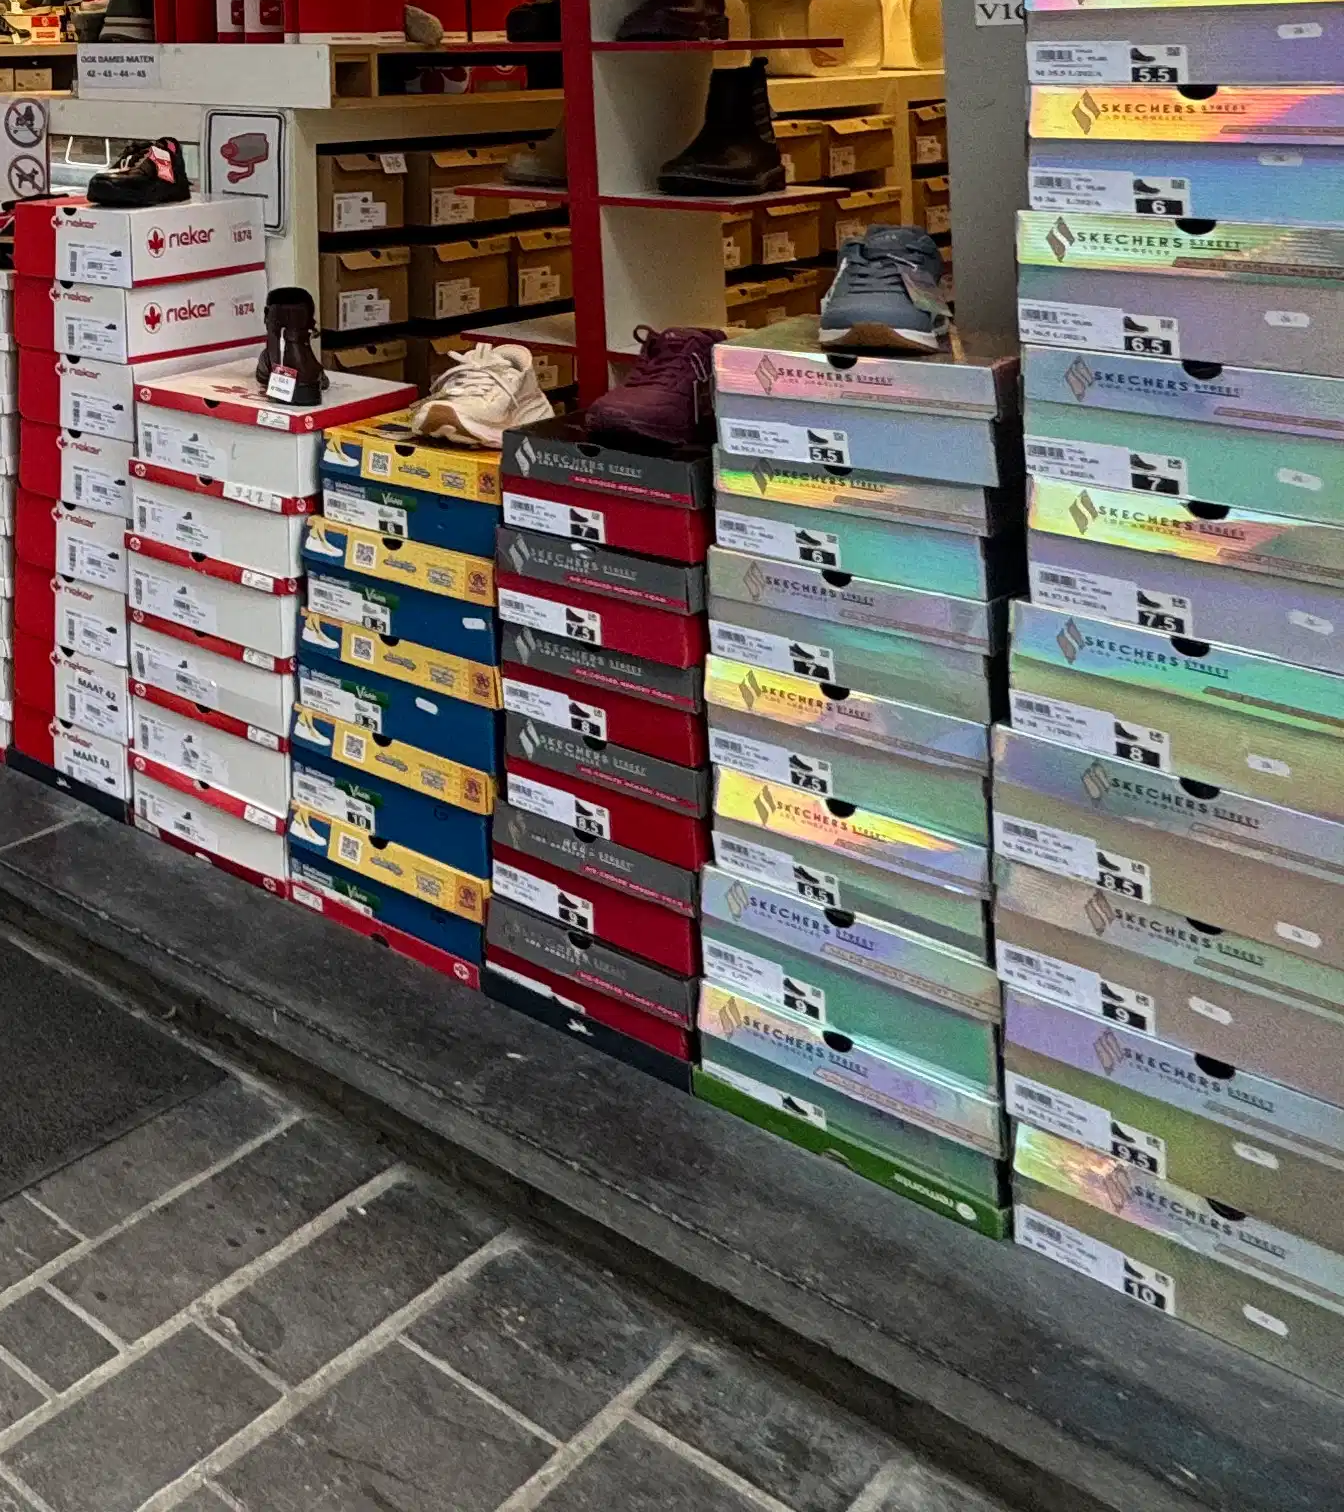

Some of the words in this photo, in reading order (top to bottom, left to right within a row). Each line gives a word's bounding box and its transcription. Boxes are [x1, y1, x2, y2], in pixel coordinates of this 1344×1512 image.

[1138, 67, 1171, 83] 5.5
[1100, 103, 1195, 115] SKECHERS
[1151, 200, 1166, 215] 6
[169, 225, 214, 248] rieker
[1077, 231, 1183, 248] SKECHERS
[1189, 238, 1241, 249] STREET
[166, 300, 215, 323] rieker
[1132, 338, 1163, 354] 6.5
[777, 366, 853, 383] SKECHERS
[1094, 370, 1189, 392] SKECHERS
[536, 449, 605, 471] SKECHERS
[811, 448, 839, 462] 5.5
[773, 467, 846, 487] SKECHERS
[1149, 476, 1162, 490] 7
[1098, 505, 1194, 531] SKECHERS
[811, 549, 823, 563] 6
[766, 574, 837, 599] SKECHERS
[1143, 612, 1177, 631] 7.5
[1085, 635, 1178, 666] SKECHERS
[78, 677, 105, 697] MAAT
[105, 690, 116, 702] 42
[760, 683, 834, 713] SKECHERS
[72, 748, 98, 765] MAAT
[99, 756, 110, 770] 43
[1129, 746, 1144, 762] 8
[1112, 777, 1208, 814] SKECHERS
[776, 799, 849, 833] SKECHERS
[1101, 875, 1136, 896] 8.5
[750, 895, 832, 937] SKECHERS
[1115, 908, 1213, 950] SKECHERS
[795, 998, 807, 1014] 9
[1115, 1007, 1130, 1023] 9
[743, 1014, 825, 1059] SKECHERS
[1123, 1046, 1222, 1093] SKECHERS
[1118, 1145, 1149, 1170] 9.5
[1135, 1186, 1233, 1237] SKECHERS
[1130, 1283, 1157, 1304] 10
